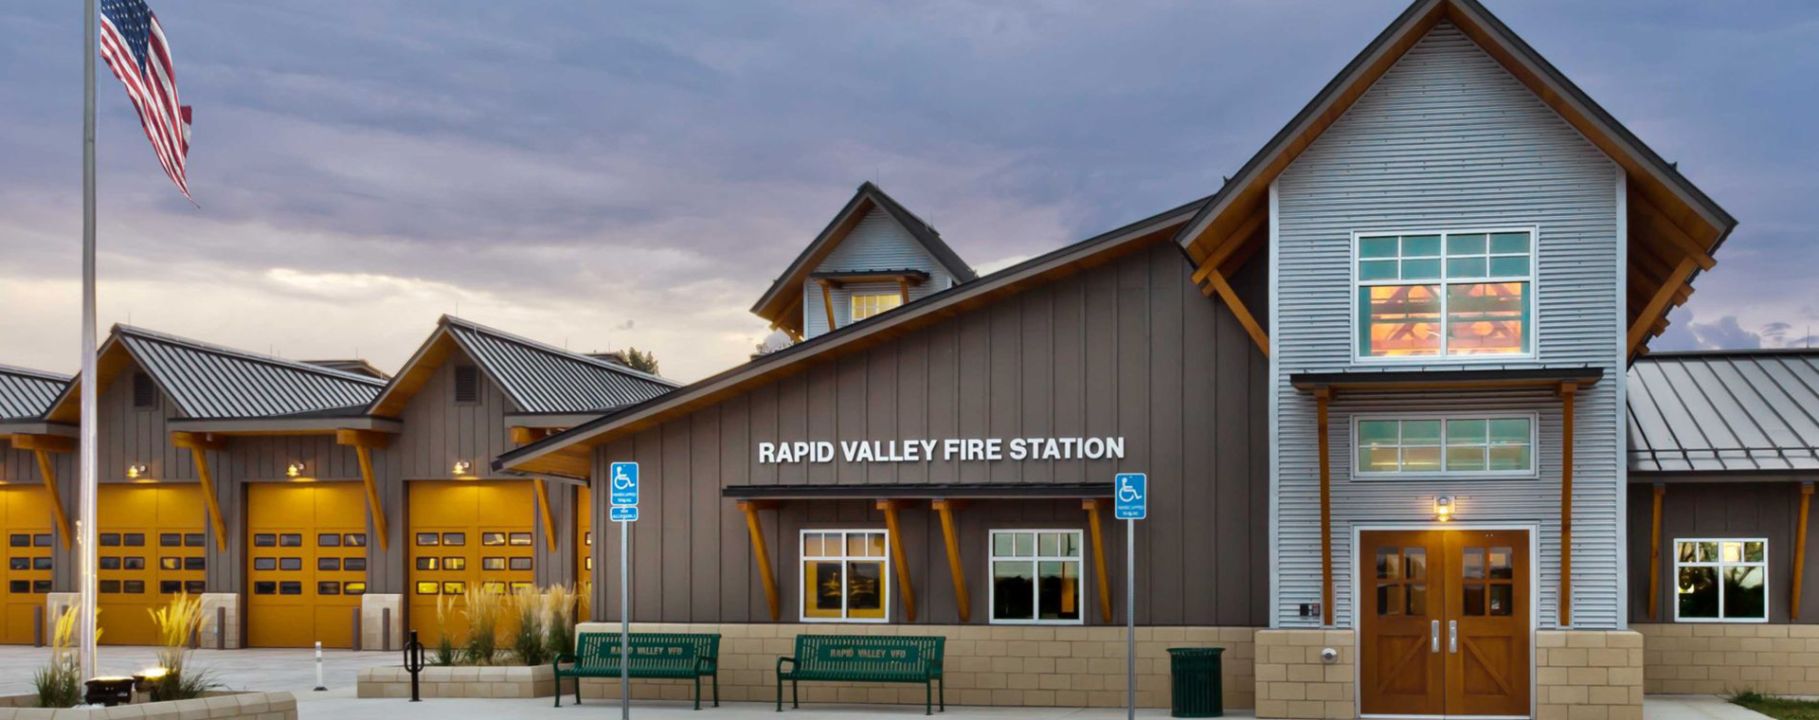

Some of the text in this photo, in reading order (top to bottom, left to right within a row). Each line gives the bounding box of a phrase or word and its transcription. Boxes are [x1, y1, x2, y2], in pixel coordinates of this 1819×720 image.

[759, 437, 1125, 463] RAPID VALLEY FIRE STATION
[610, 646, 634, 654] RAD
[637, 646, 664, 655] VALLEY
[830, 649, 854, 658] RAPID
[858, 649, 886, 658] VALLEY
